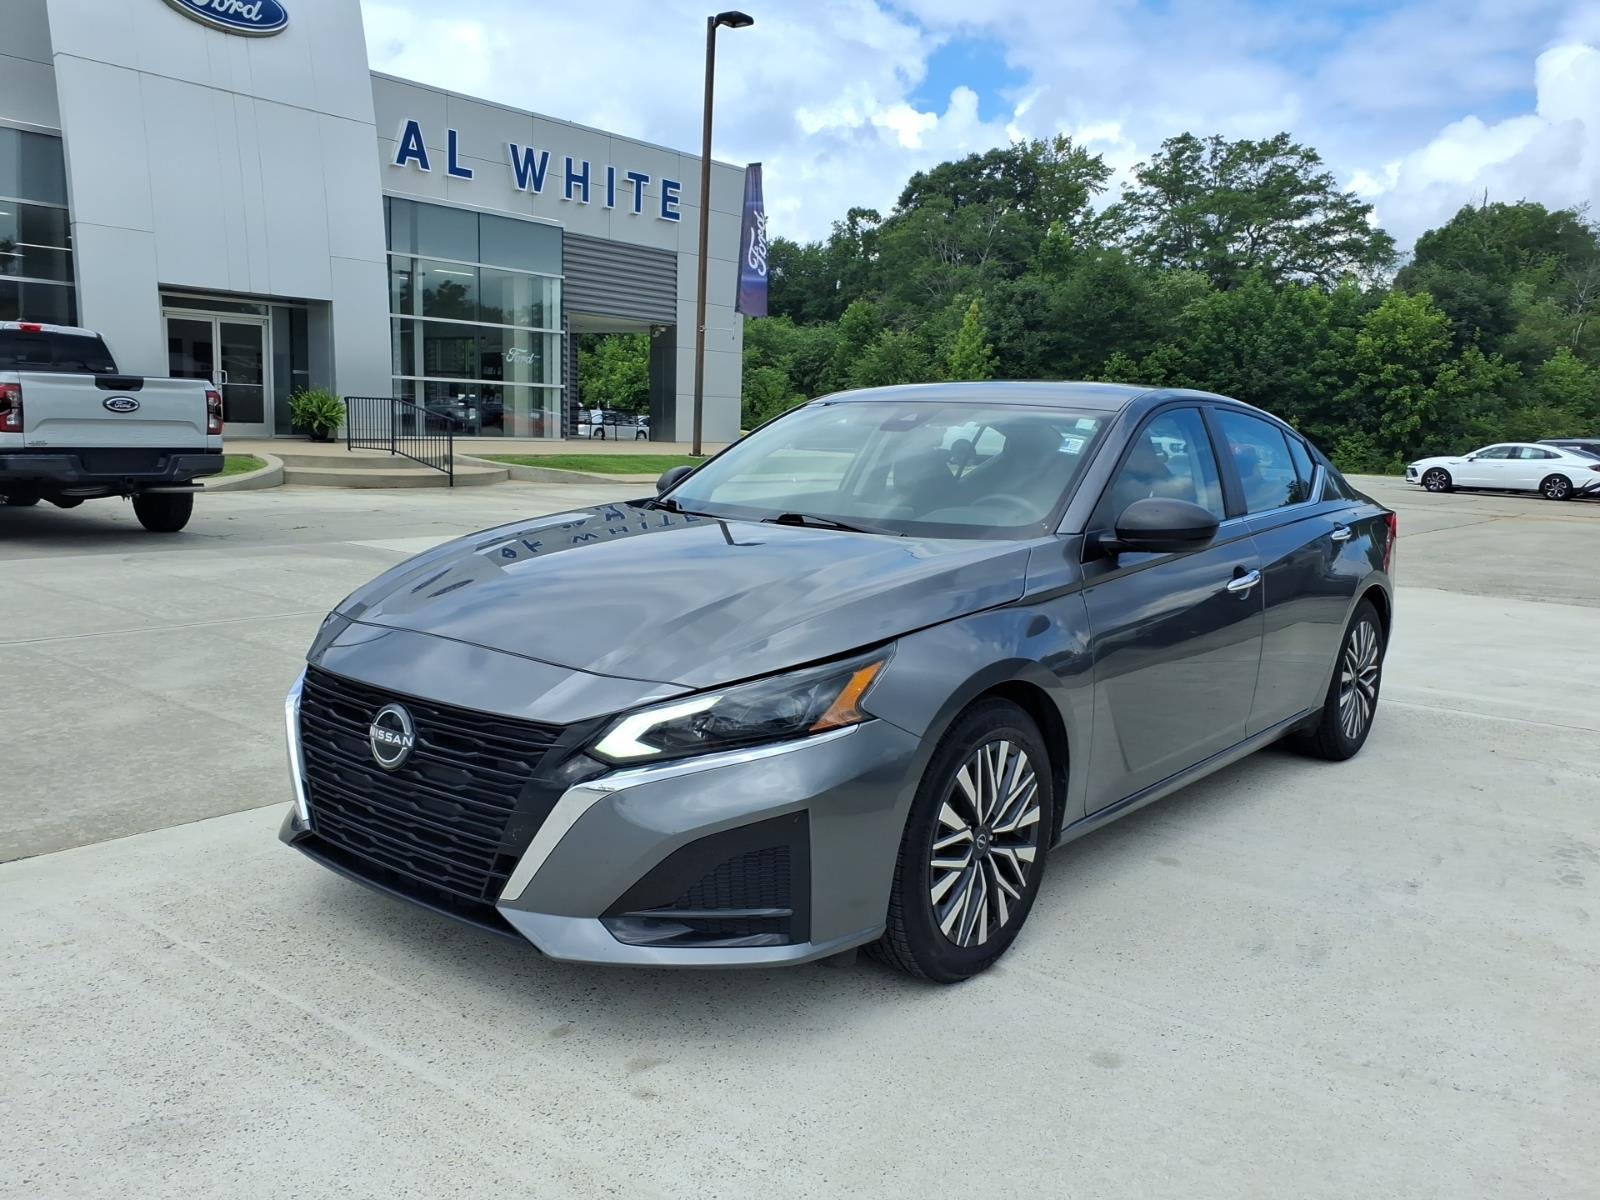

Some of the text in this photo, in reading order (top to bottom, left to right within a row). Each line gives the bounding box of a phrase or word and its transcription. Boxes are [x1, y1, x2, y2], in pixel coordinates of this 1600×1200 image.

[191, 0, 263, 21] ord
[392, 118, 682, 223] AL WHITE
[748, 210, 767, 276] Ford
[506, 347, 535, 365] Ford
[370, 726, 413, 747] NISSAN
